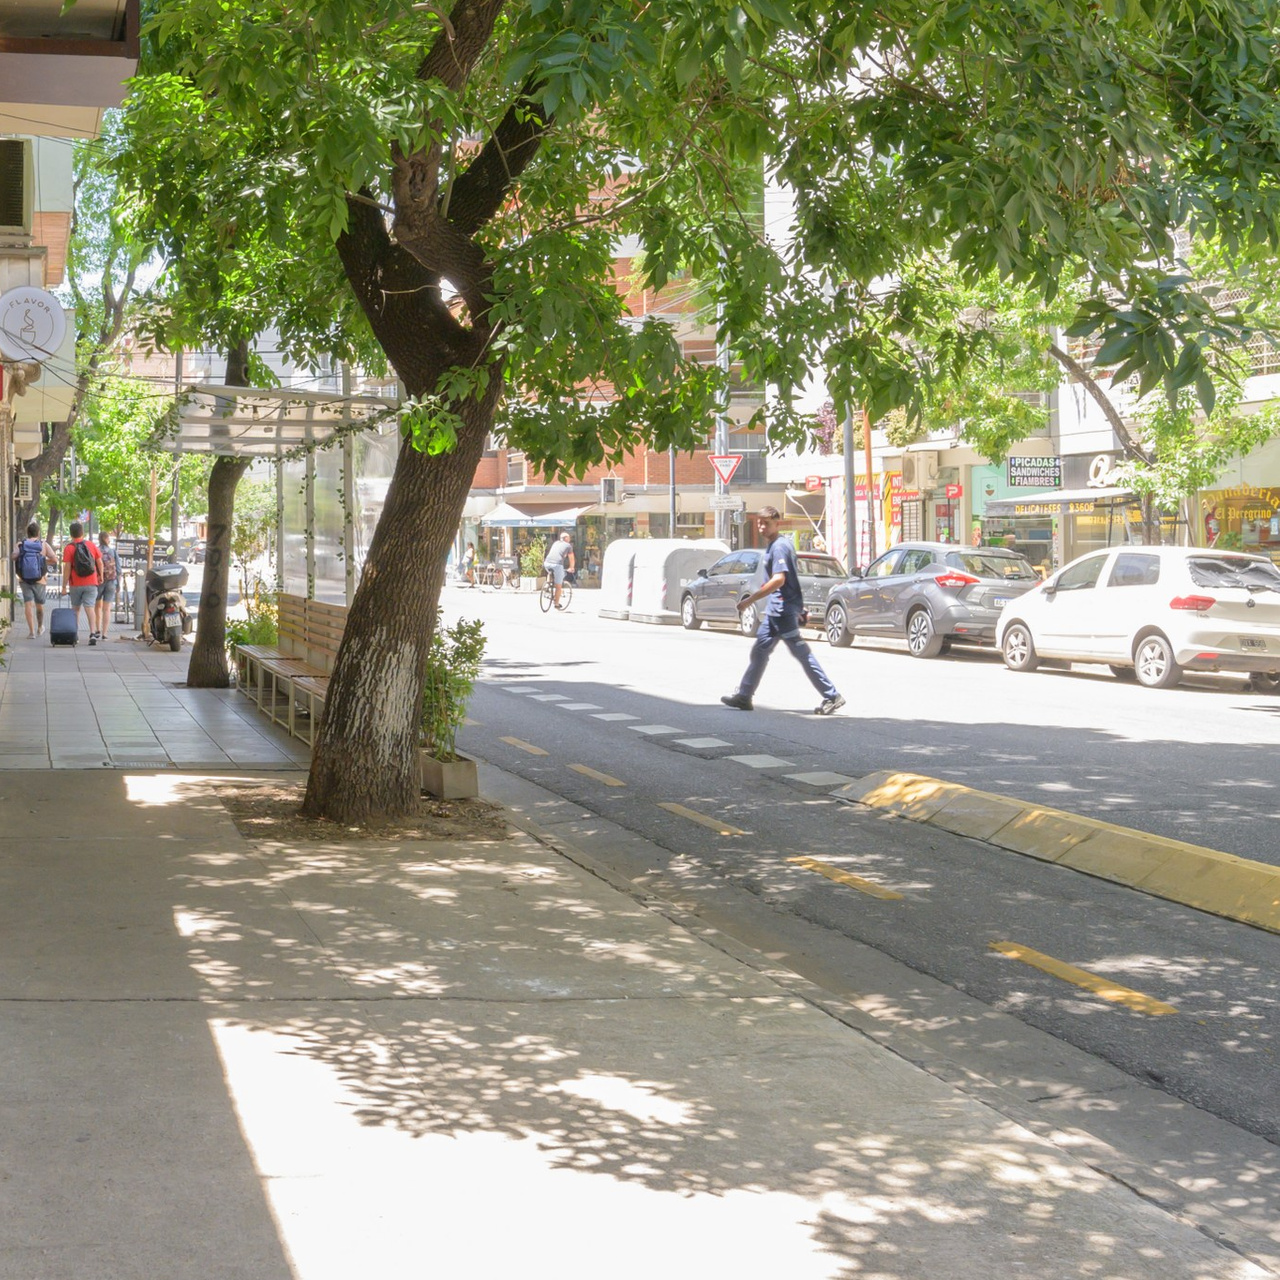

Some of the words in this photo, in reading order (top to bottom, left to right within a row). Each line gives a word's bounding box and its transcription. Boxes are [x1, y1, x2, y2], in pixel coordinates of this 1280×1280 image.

[8, 297, 52, 314] FLAVOR
[1015, 458, 1055, 467] PICADAS
[1010, 467, 1060, 477] SANDWICHES
[1015, 477, 1055, 486] FIAMBRES
[1015, 504, 1061, 515] DELICATESES
[1228, 507, 1272, 521] Peregrino
